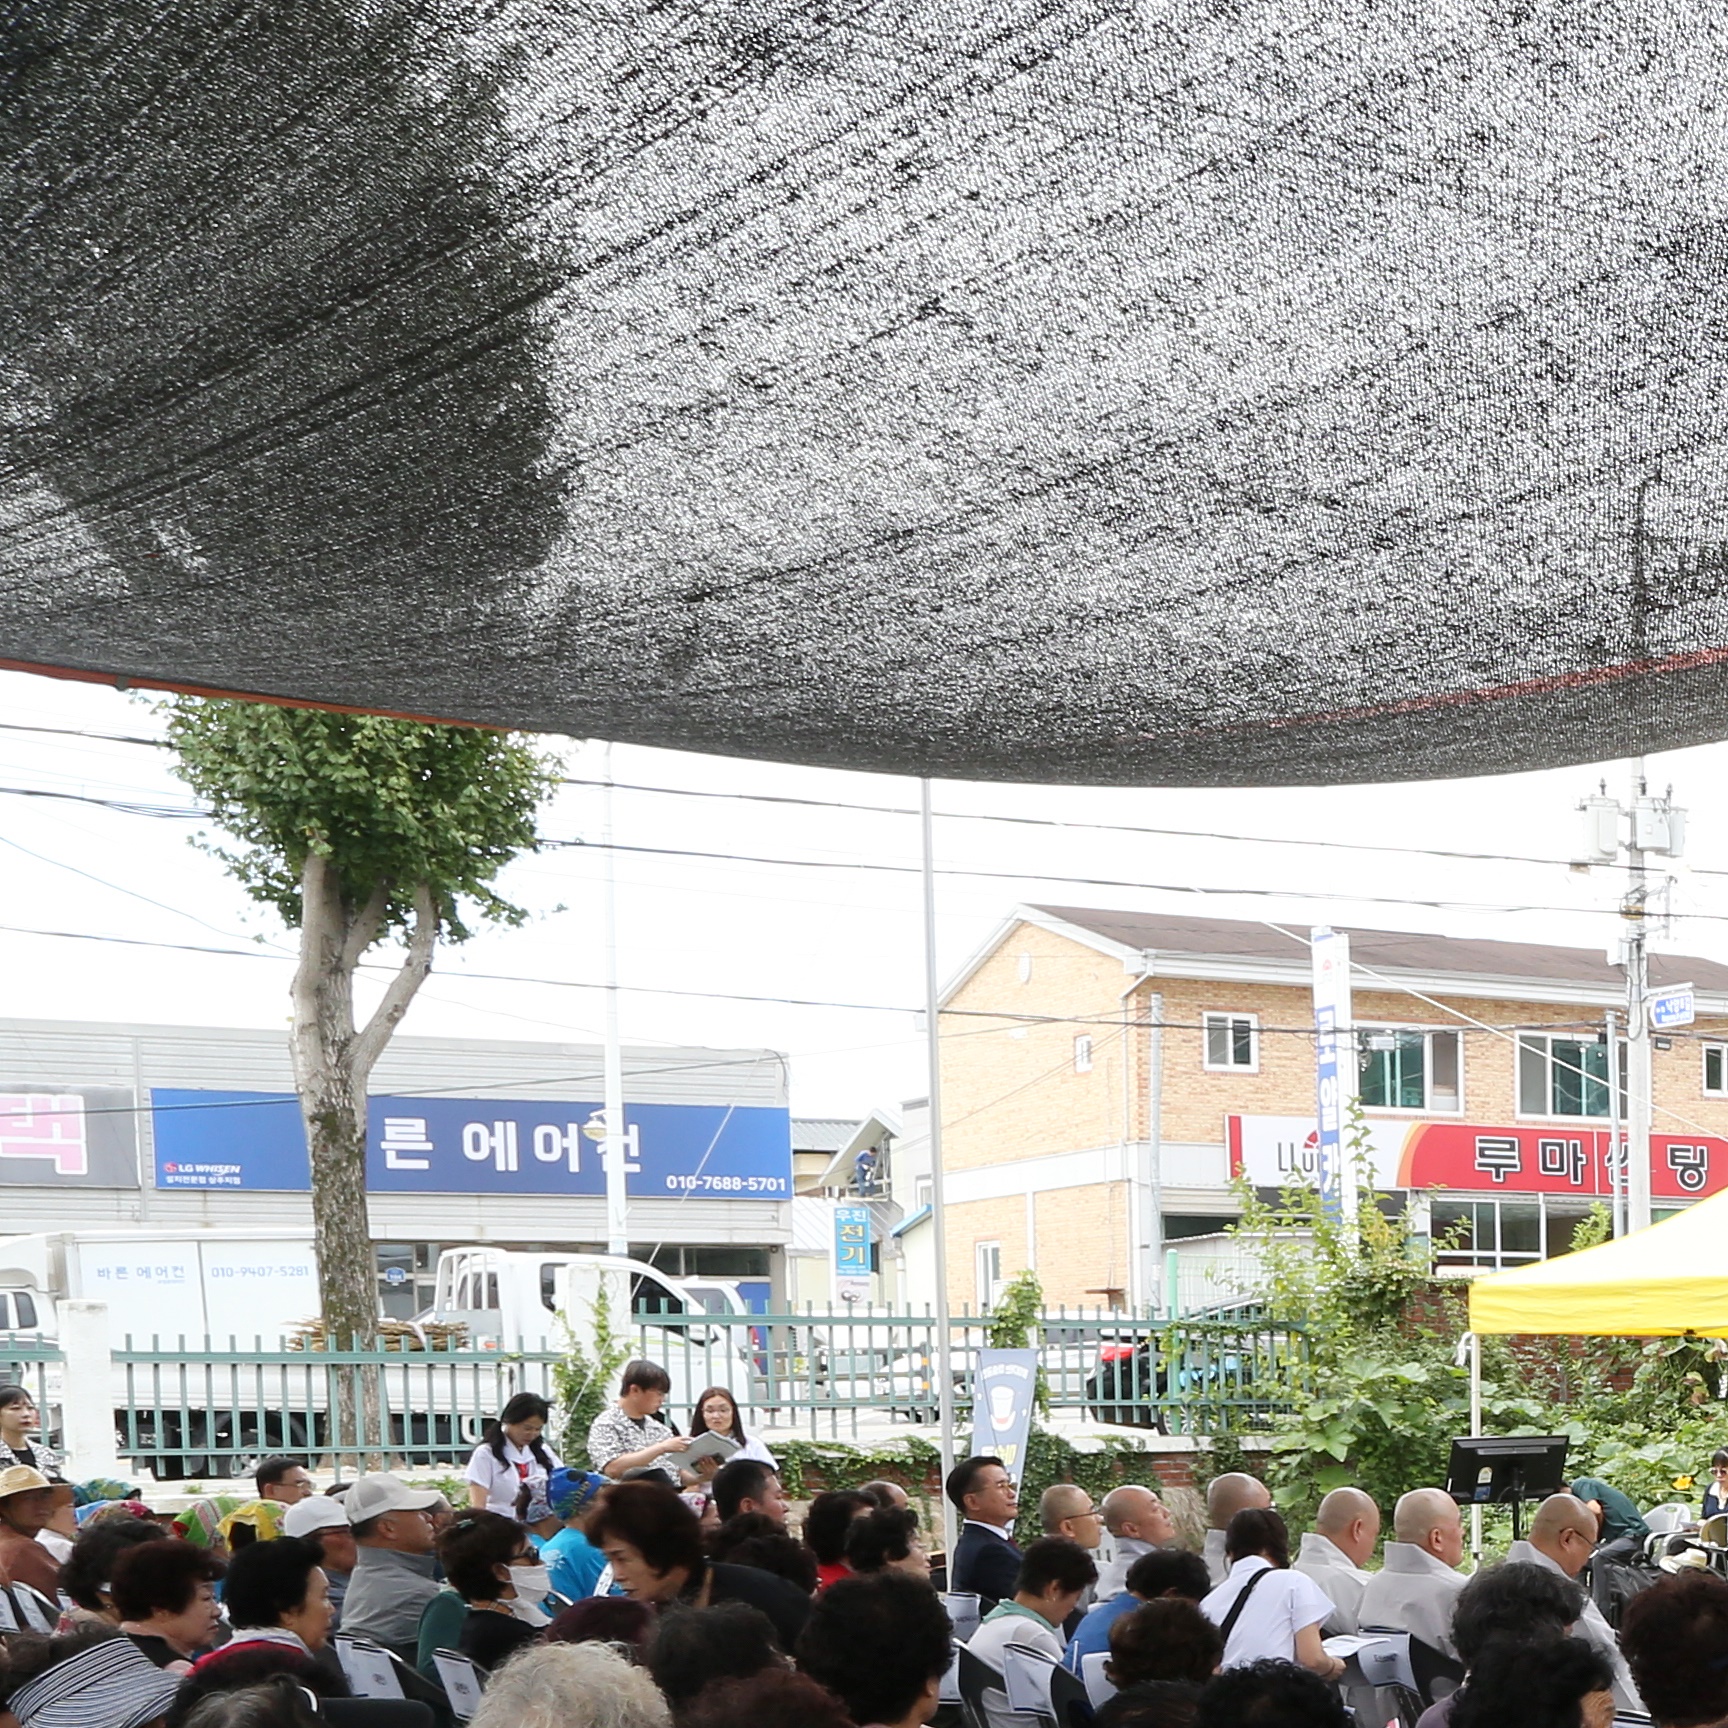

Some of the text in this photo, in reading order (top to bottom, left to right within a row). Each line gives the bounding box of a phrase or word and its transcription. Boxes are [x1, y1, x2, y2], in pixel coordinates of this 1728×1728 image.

[178, 1163, 241, 1175] LG WHISEN
[665, 1174, 786, 1192] 010-7688-5701
